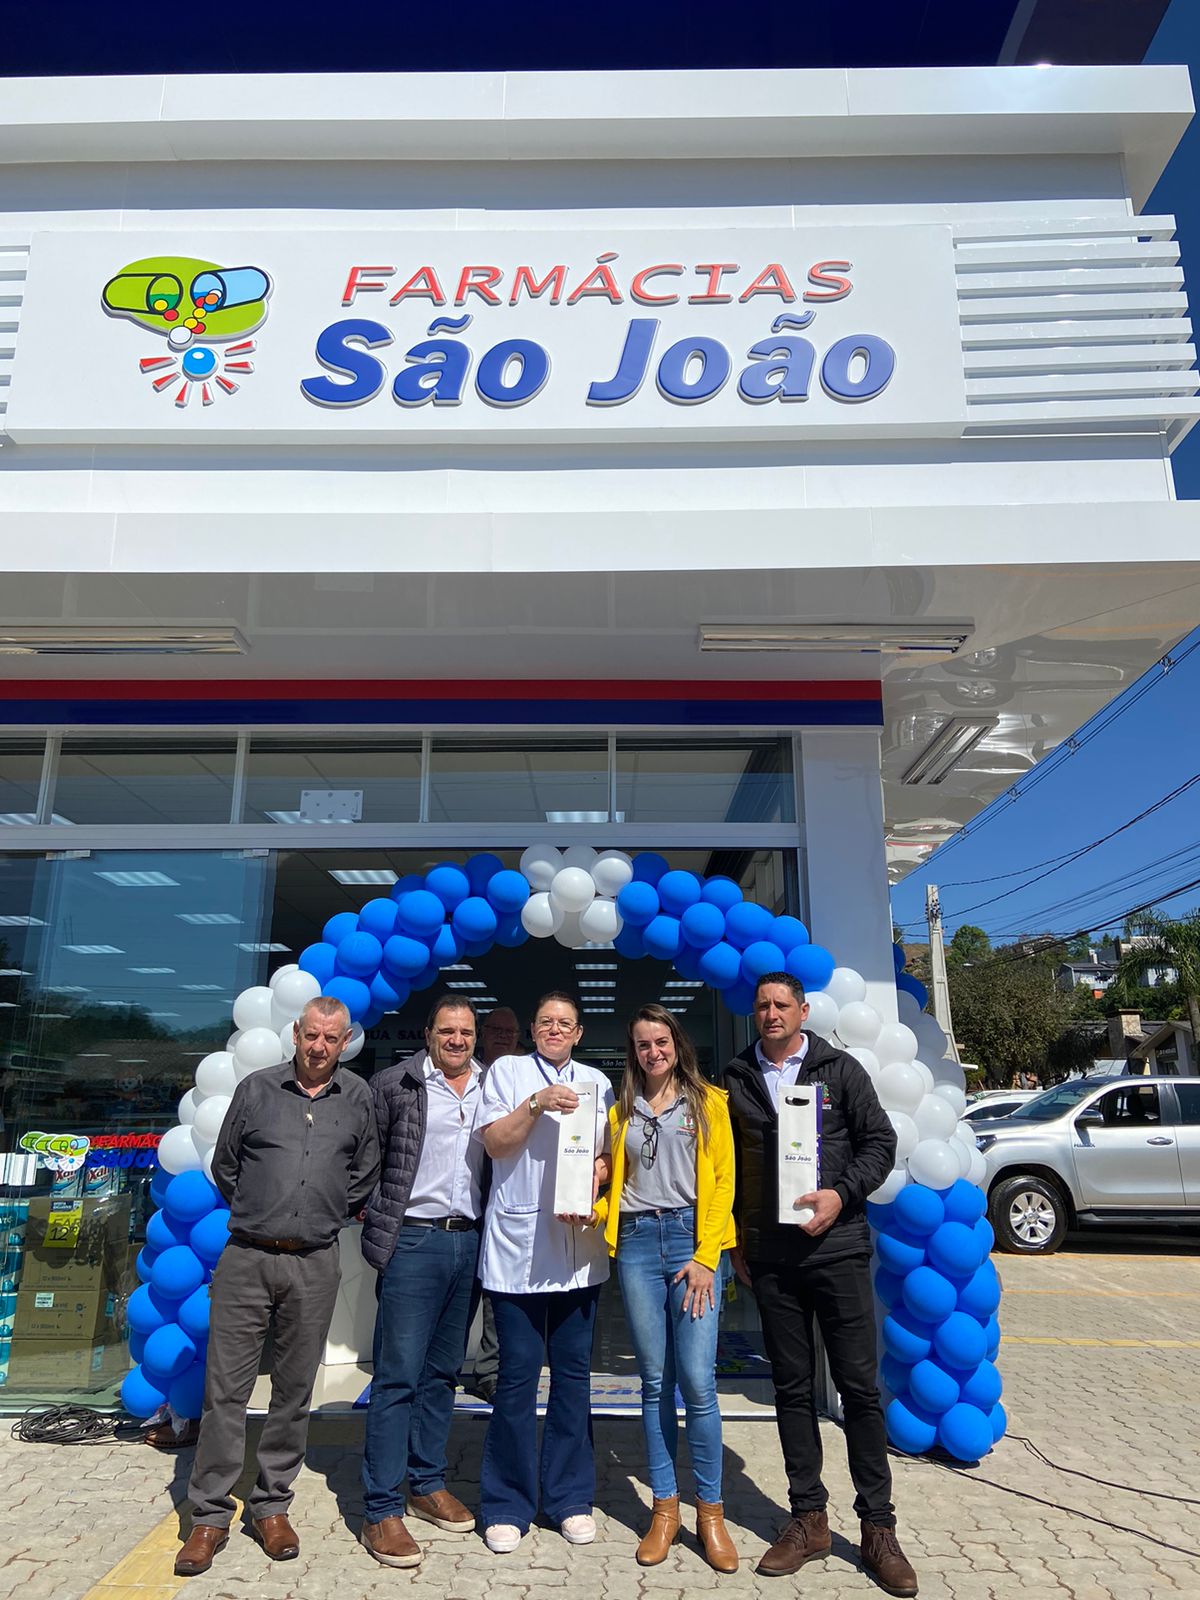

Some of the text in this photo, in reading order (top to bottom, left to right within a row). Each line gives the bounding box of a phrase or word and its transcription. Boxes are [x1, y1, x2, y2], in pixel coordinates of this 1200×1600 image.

[342, 252, 855, 305] FARMÁCIAS
[300, 311, 898, 406] São João
[398, 1030, 425, 1040] SAU
